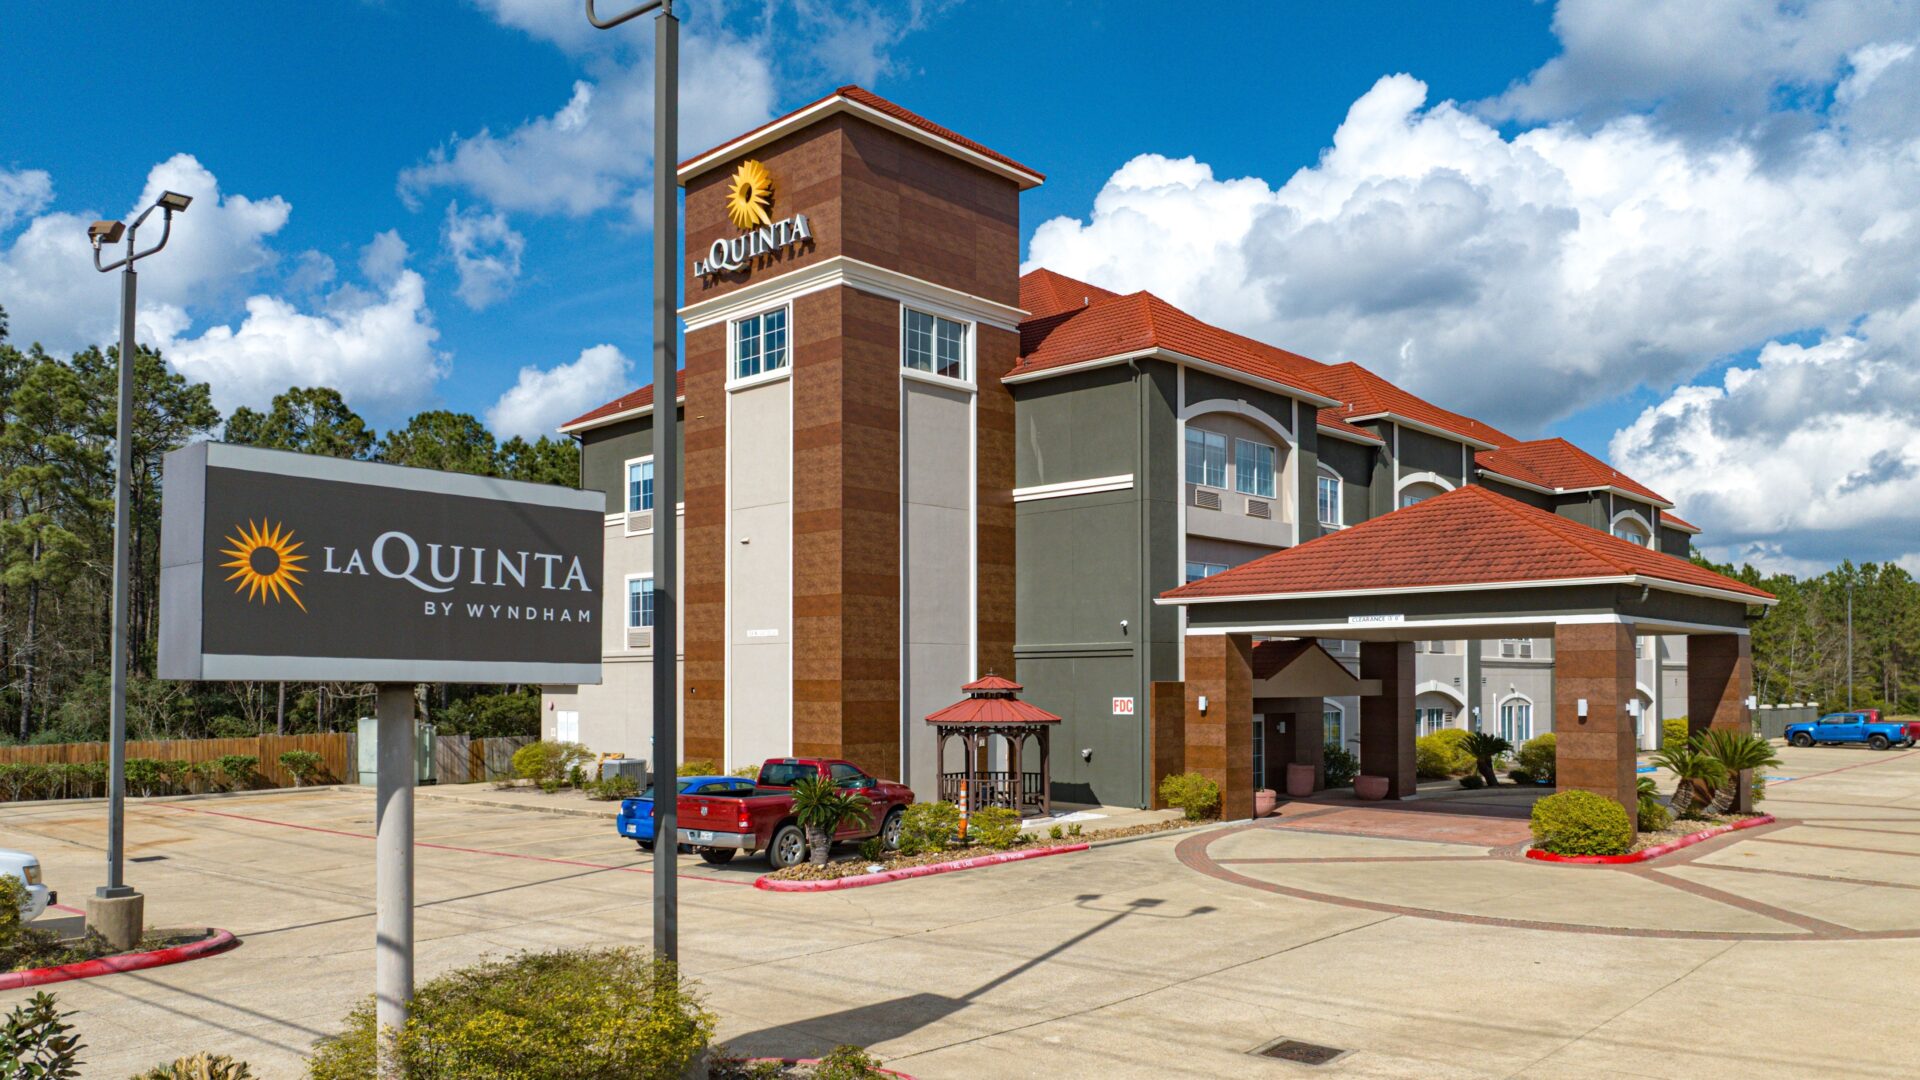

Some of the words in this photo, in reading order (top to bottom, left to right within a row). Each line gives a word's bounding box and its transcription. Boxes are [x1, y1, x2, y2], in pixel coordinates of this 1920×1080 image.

[709, 213, 812, 270] QUINTA
[323, 546, 369, 576] LA
[371, 531, 593, 593] QUINTA
[424, 601, 454, 616] BY
[467, 603, 591, 623] WYNDHAM
[1113, 699, 1133, 713] FDC
